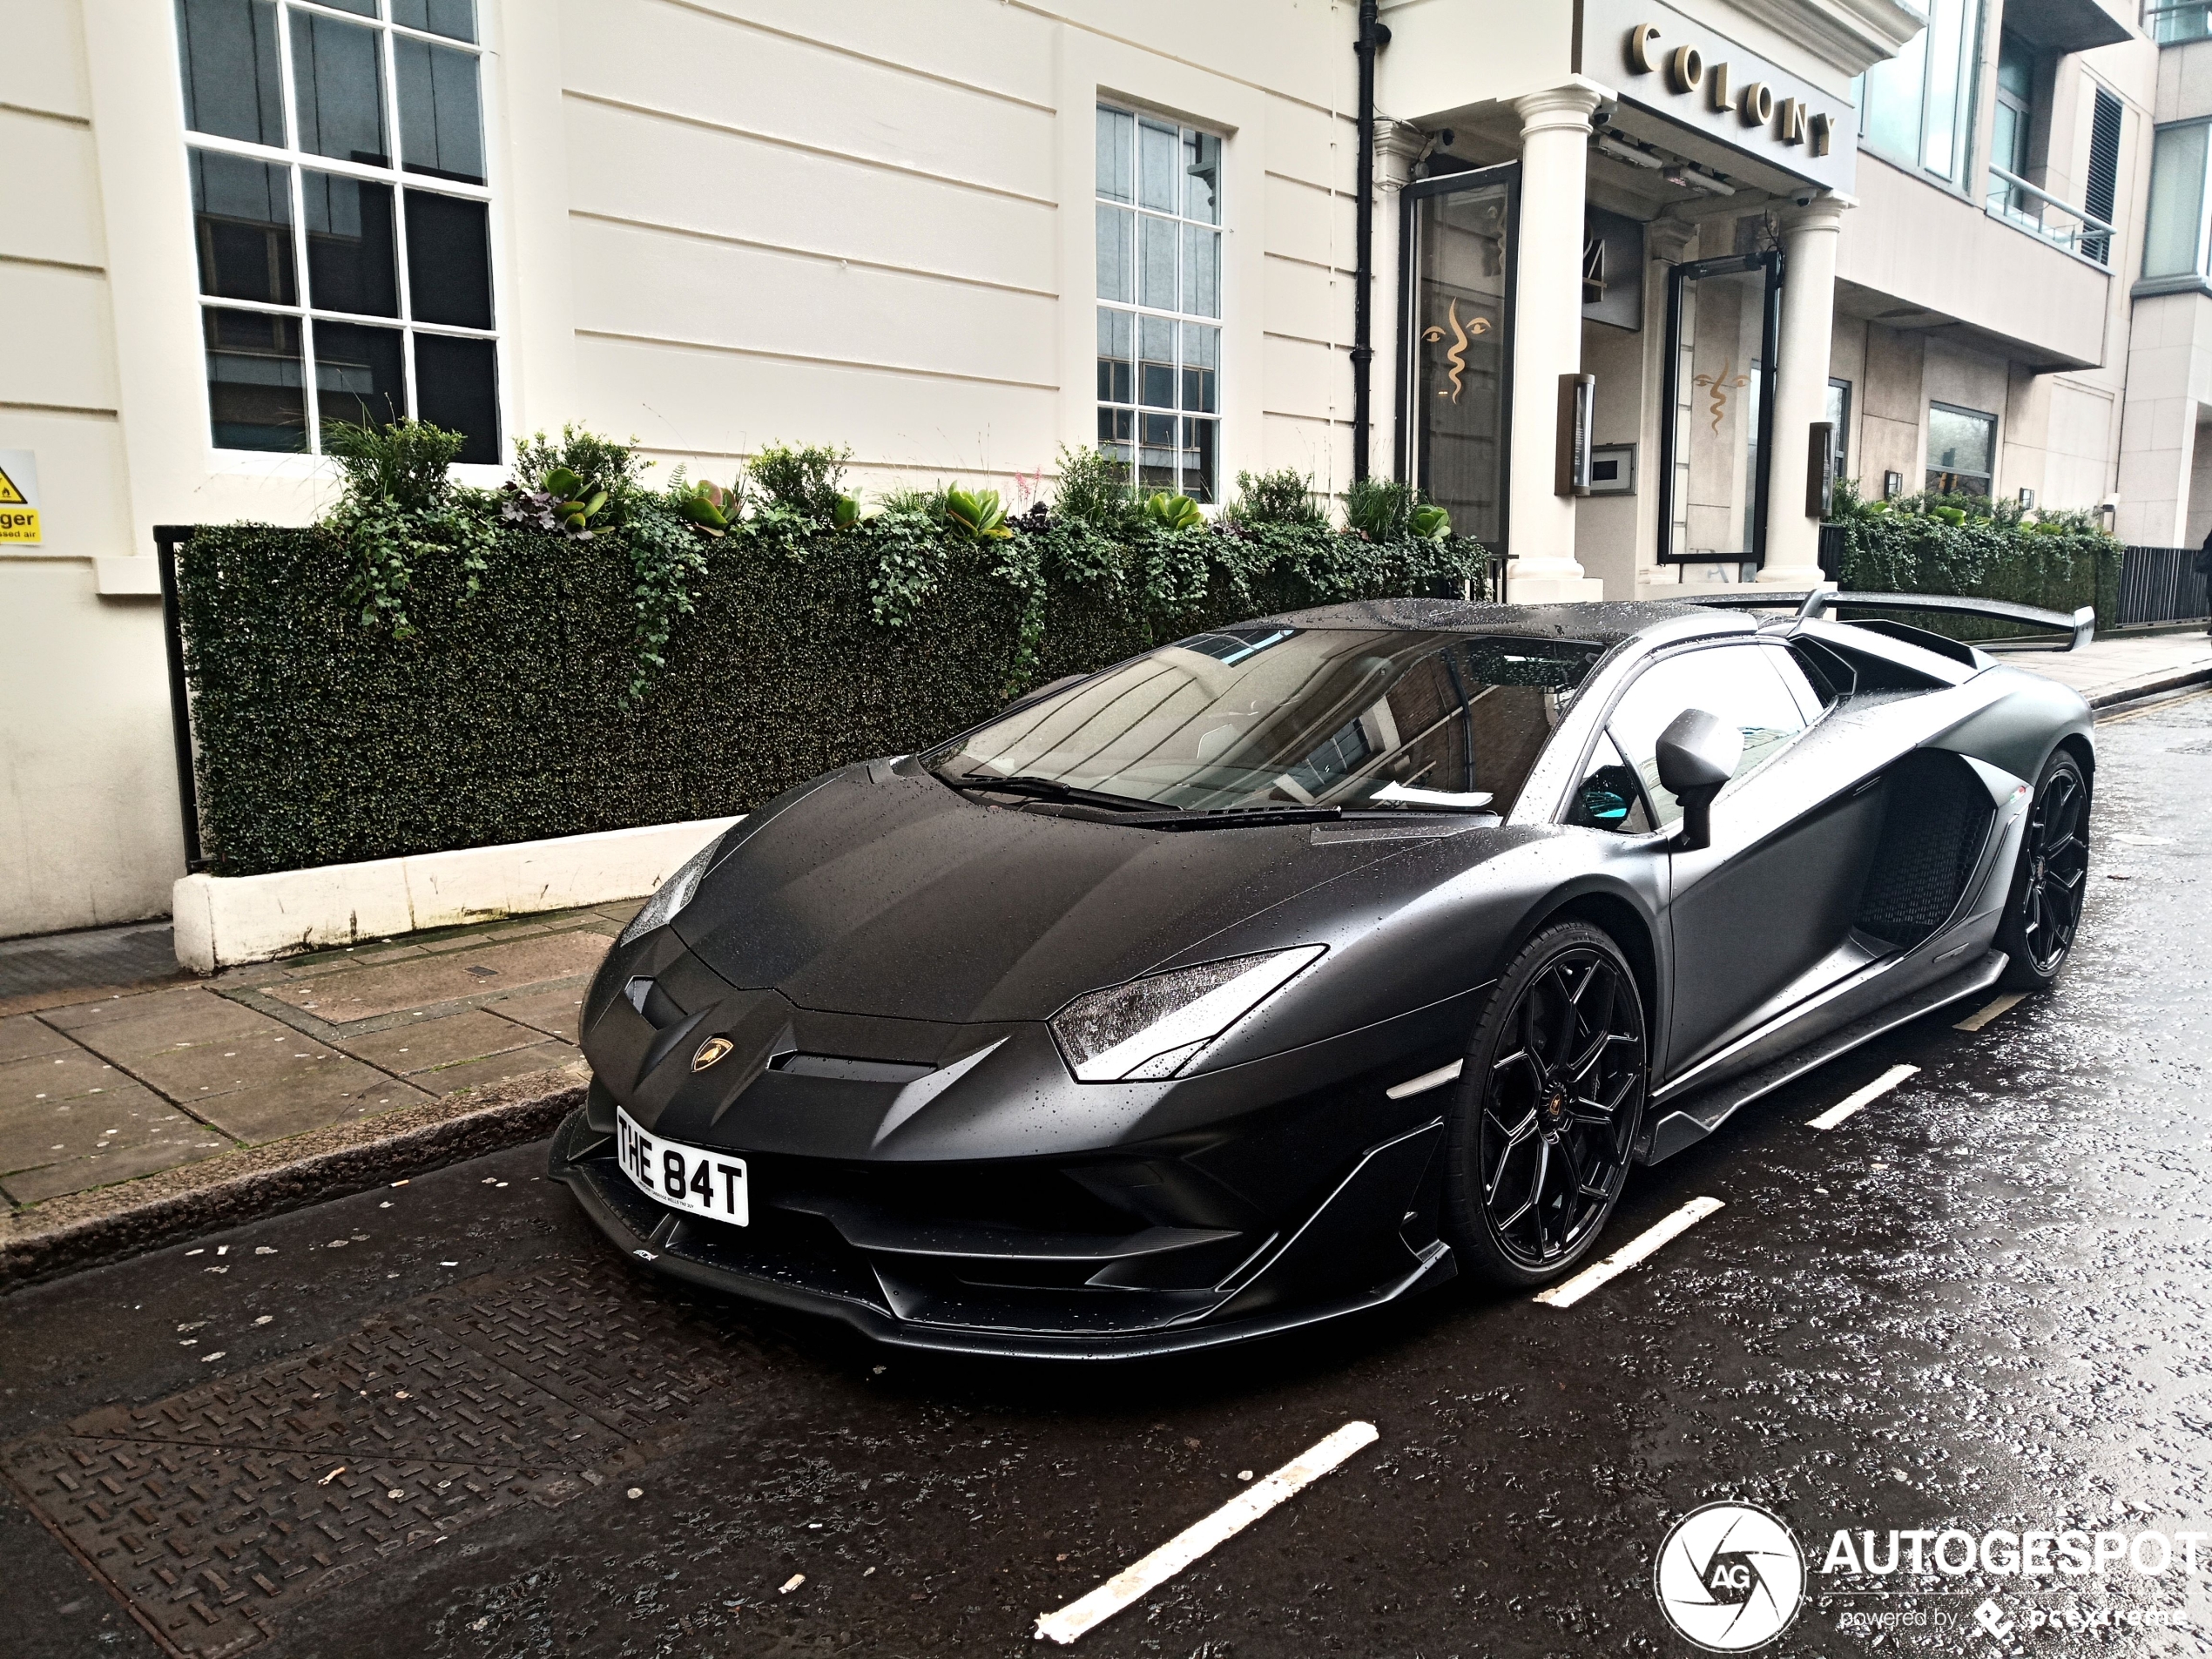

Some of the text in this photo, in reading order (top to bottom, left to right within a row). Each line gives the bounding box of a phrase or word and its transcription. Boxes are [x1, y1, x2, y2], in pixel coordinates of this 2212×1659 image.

[1632, 22, 1835, 157] COLONY
[618, 1115, 742, 1215] THE 84T
